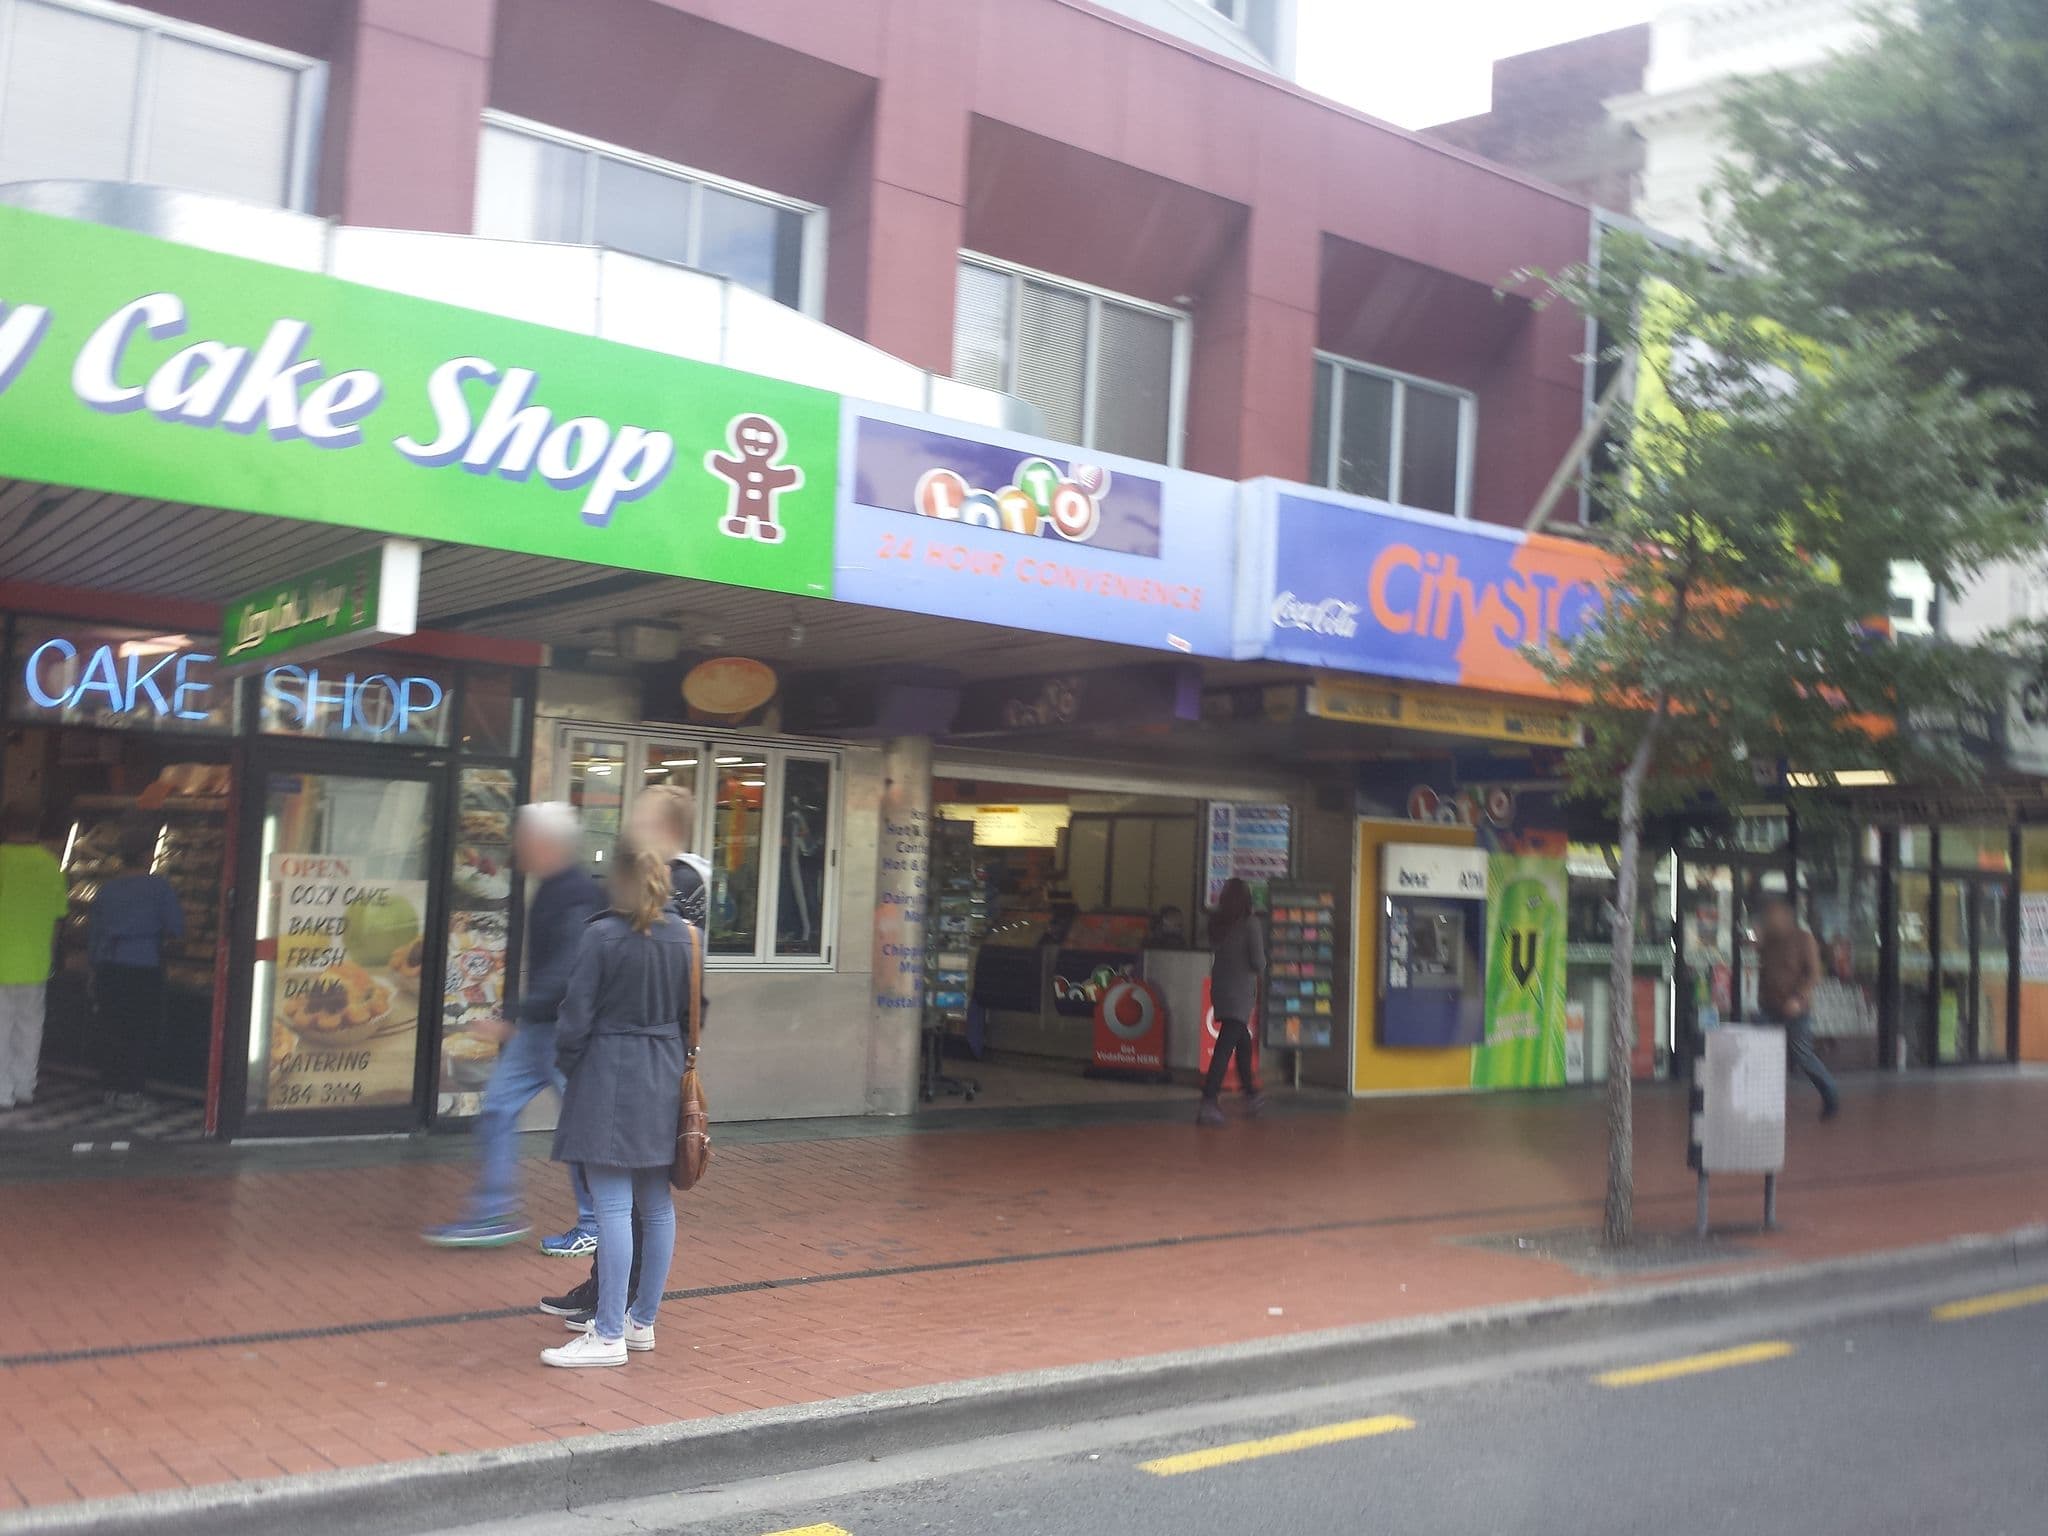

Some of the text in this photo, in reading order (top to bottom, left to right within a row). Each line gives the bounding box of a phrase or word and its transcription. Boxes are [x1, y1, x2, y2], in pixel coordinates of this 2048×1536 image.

[72, 292, 384, 447] Cake
[393, 356, 675, 526] Shop
[876, 532, 1206, 614] 24 HOUR CONVENIENCE
[25, 638, 444, 735] CAKE SHOP
[281, 857, 350, 878] OPEN
[290, 884, 392, 906] COZY CAKE
[287, 916, 348, 936] BAKED
[286, 946, 347, 968] FRESH
[279, 1050, 371, 1073] CATERING
